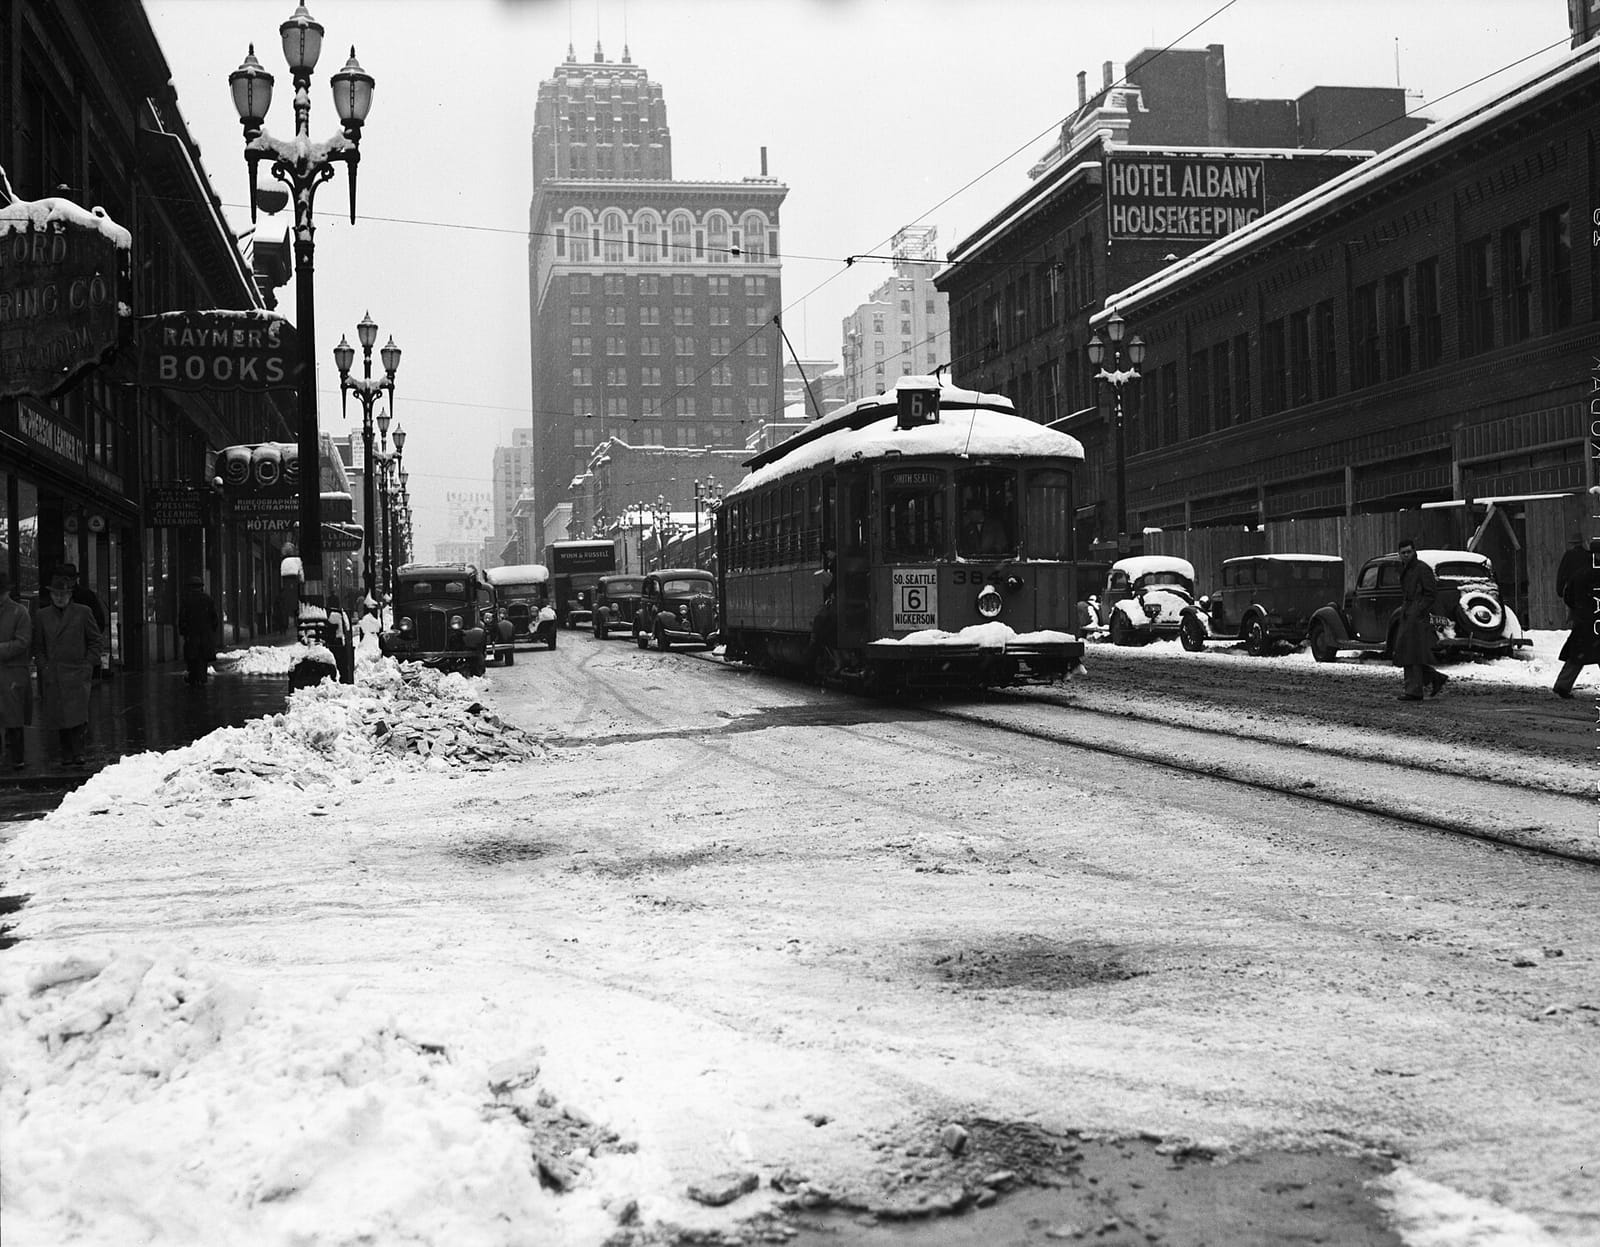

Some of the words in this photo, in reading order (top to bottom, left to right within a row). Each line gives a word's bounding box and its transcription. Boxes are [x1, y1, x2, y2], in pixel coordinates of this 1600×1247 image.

[1111, 163, 1177, 196] HOTEL
[1181, 165, 1261, 198] ALBANY
[12, 233, 67, 264] ORD
[159, 354, 285, 382] BOOKS
[911, 393, 923, 416] 6
[156, 510, 199, 518] CLEANING
[247, 519, 291, 530] NOTARY
[584, 550, 609, 559] RUSSELL
[953, 571, 1003, 584] 384
[908, 589, 921, 609] 6
[895, 613, 935, 624] NICKERSON
